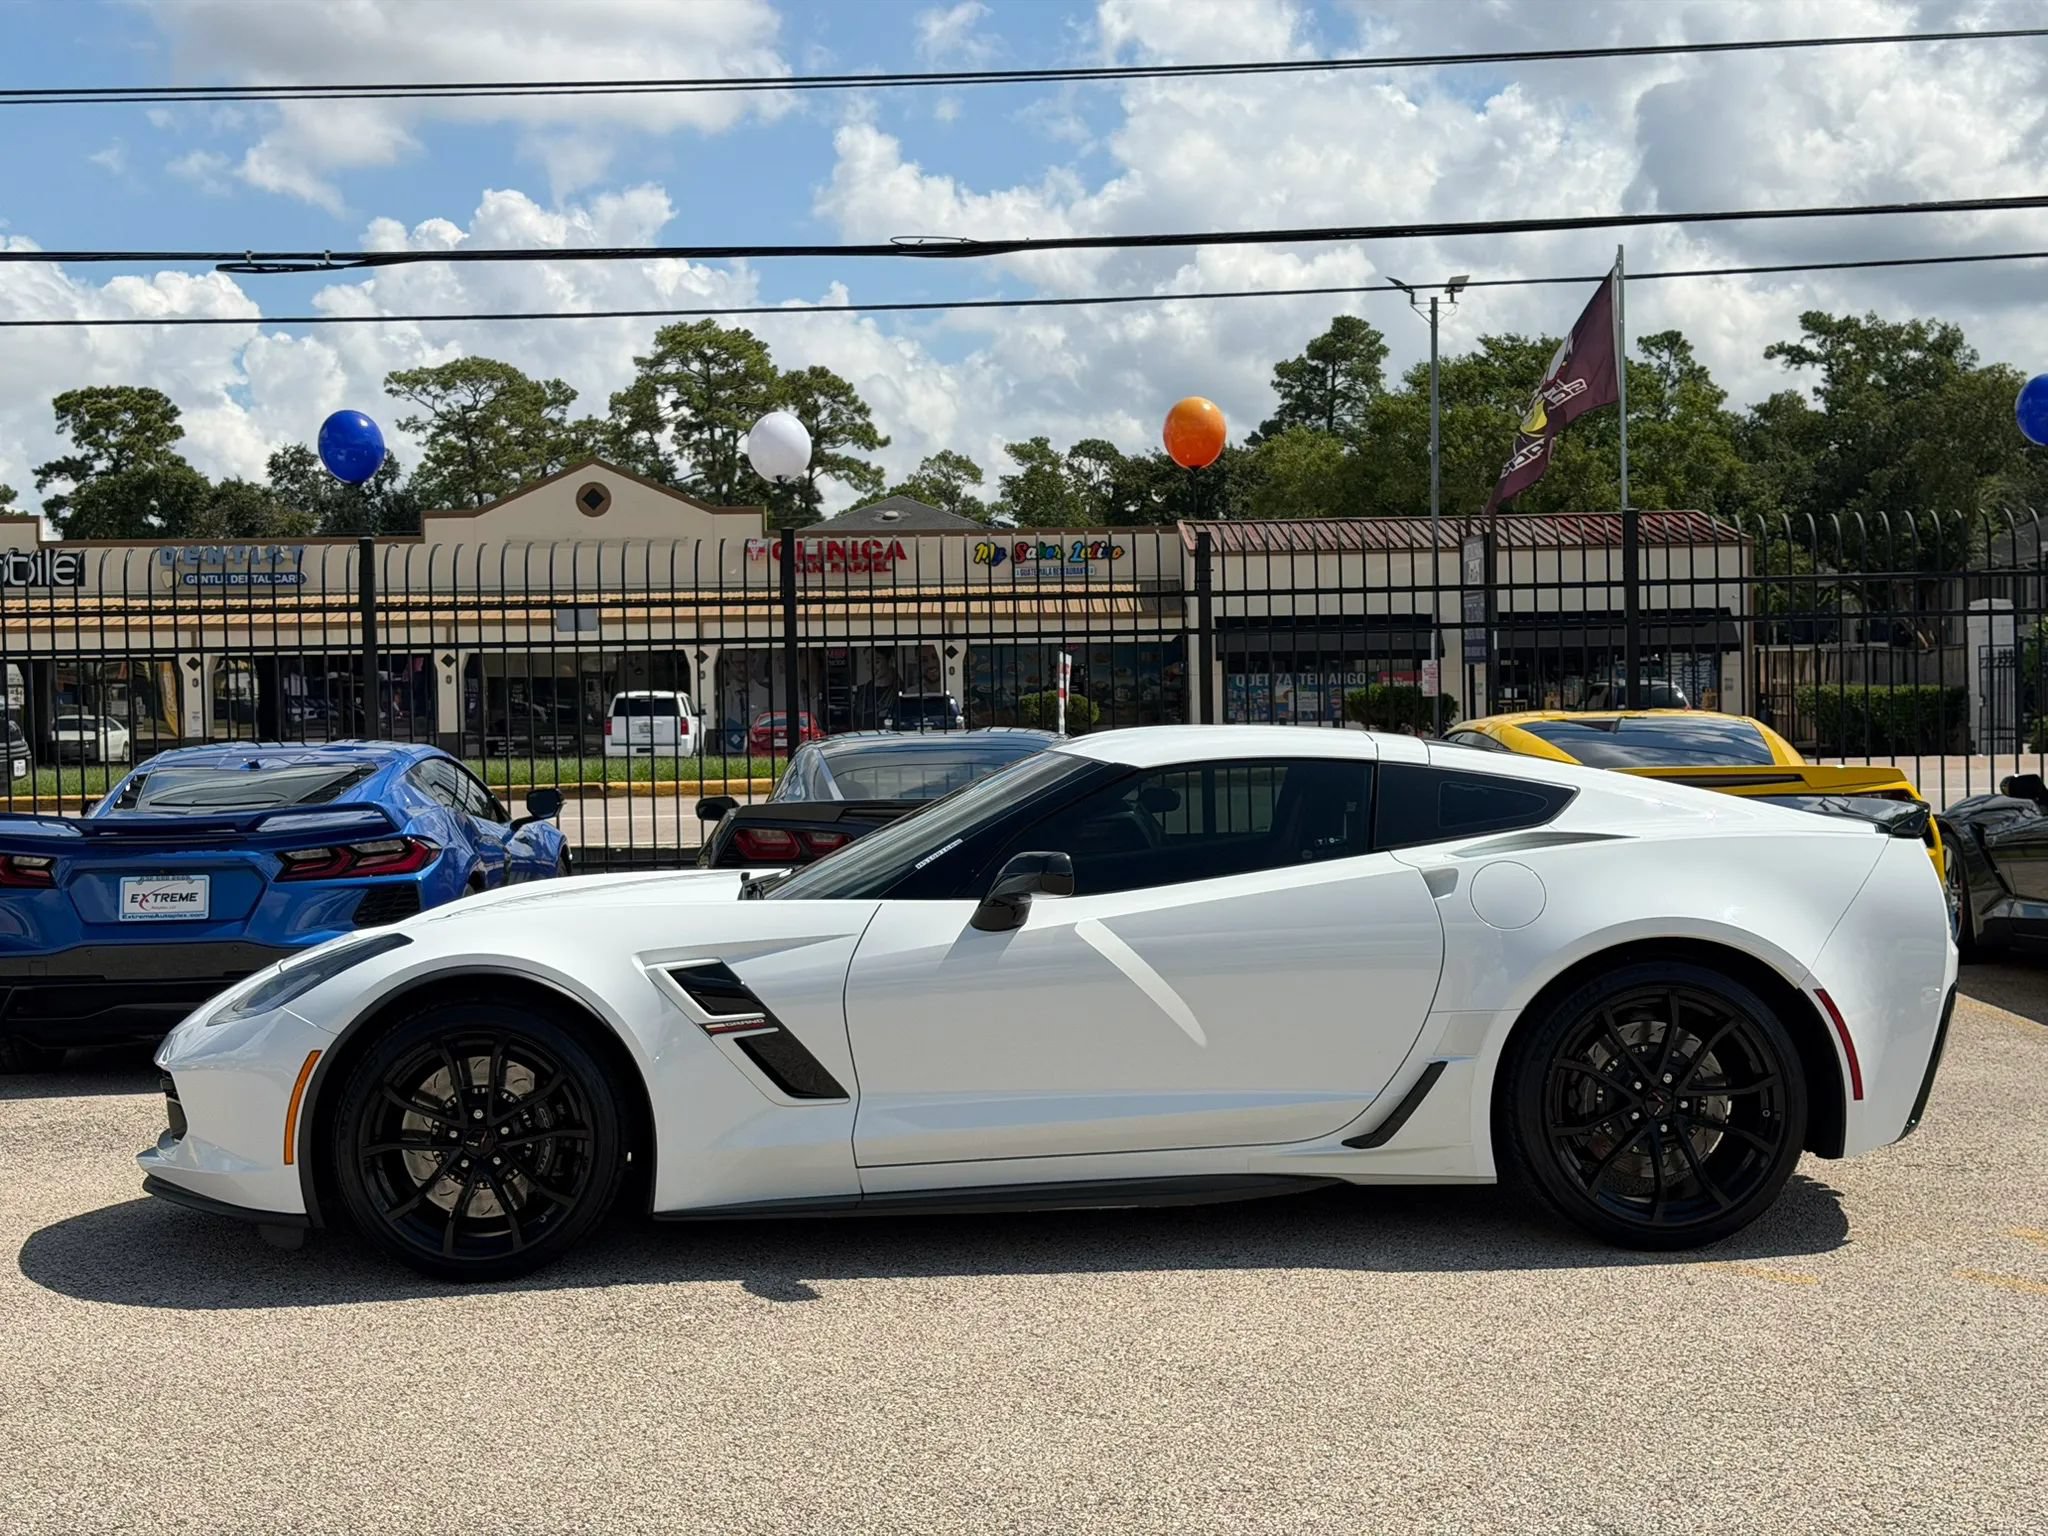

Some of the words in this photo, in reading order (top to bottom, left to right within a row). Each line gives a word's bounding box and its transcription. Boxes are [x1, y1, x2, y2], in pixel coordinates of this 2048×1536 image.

[160, 544, 304, 566] DENTIST
[1236, 672, 1366, 688] QUETZATENANGO
[130, 892, 199, 904] EXTREME
